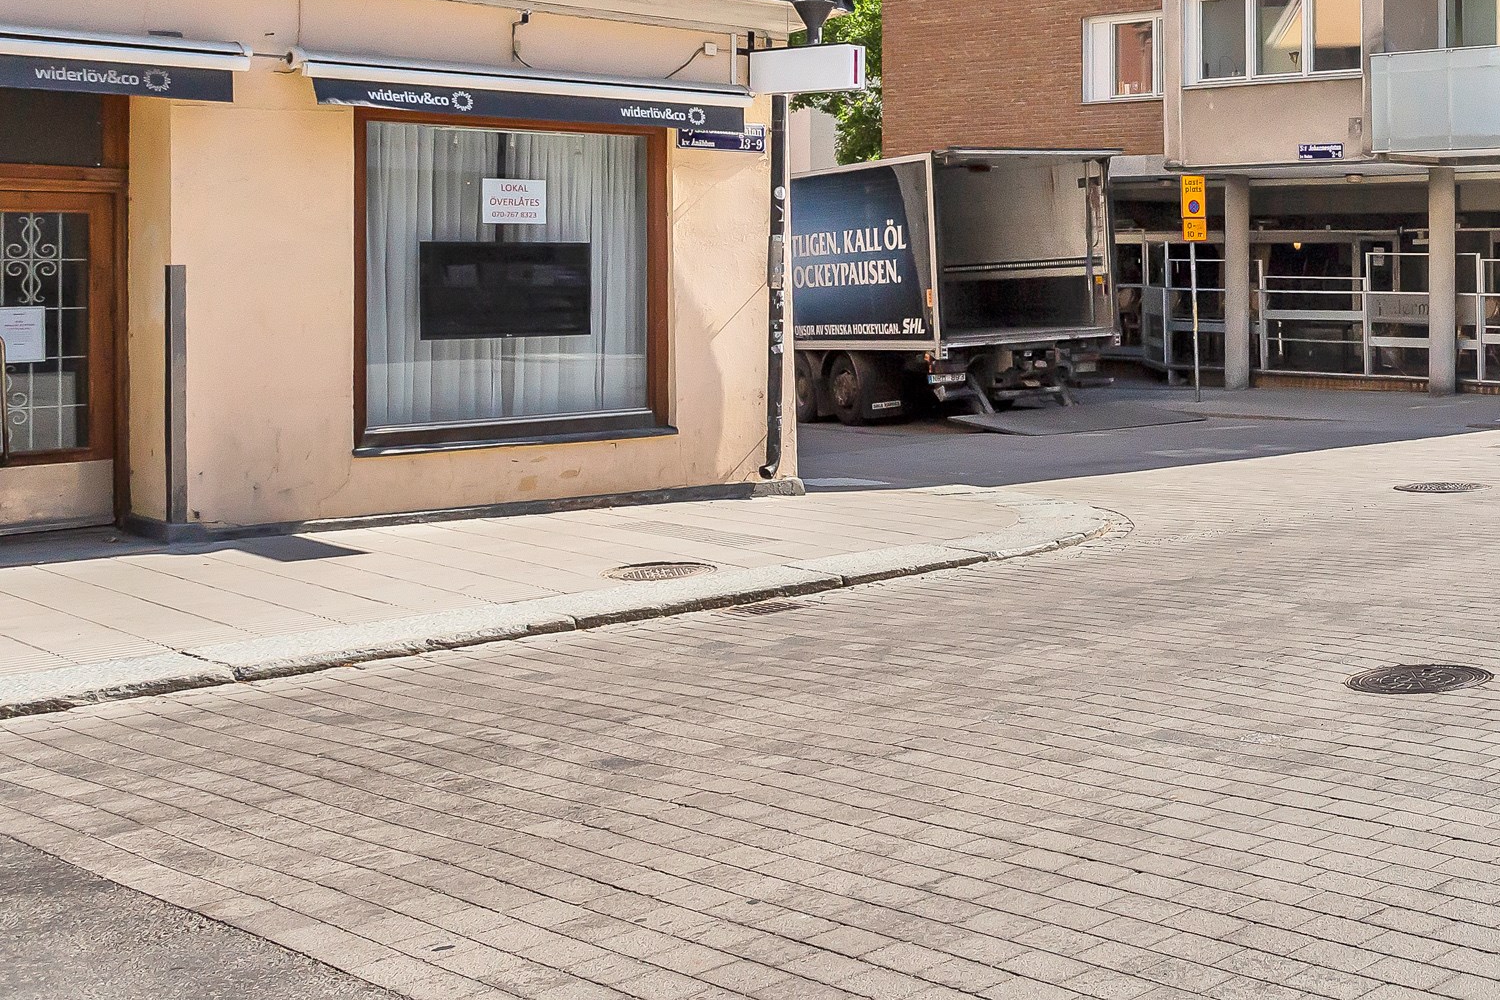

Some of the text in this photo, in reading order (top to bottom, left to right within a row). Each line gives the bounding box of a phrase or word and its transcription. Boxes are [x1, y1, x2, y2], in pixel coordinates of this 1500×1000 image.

[35, 66, 140, 86] widerlöv&co
[367, 89, 450, 106] widerlöv&co
[620, 106, 686, 121] widerlöv&co
[739, 138, 763, 150] 13-9
[501, 184, 529, 193] LOKAL
[489, 196, 540, 207] ÖVERLÅTES
[843, 227, 883, 254] KALL
[883, 219, 907, 251] ÖL
[793, 259, 902, 289] OCKEYPAUSEN.
[824, 324, 853, 335] SVENSKA
[852, 323, 901, 335] HOCKEYLIGAN.
[902, 317, 926, 335] SHL
